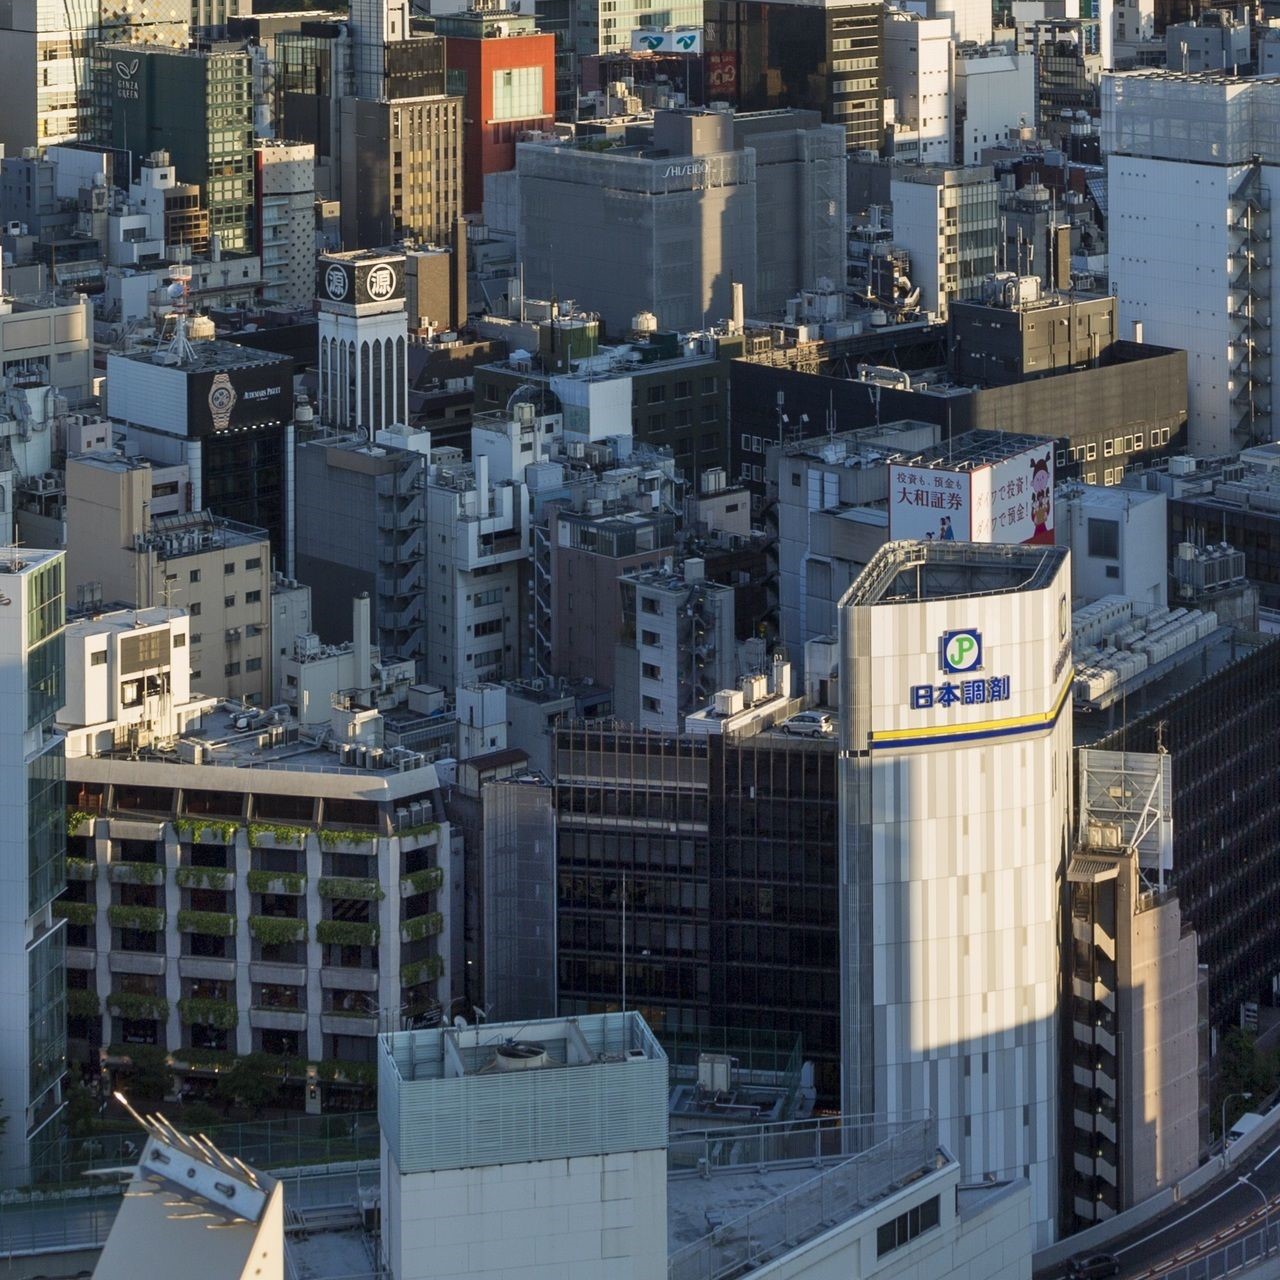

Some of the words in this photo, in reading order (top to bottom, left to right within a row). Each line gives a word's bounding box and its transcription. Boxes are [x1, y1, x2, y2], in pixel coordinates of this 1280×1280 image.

[117, 80, 139, 90] GINZA
[117, 90, 139, 99] GREEN
[662, 163, 708, 178] SHISEIDO
[328, 271, 344, 296] 源
[370, 269, 392, 295] 源
[897, 471, 962, 490] 投資も、預金も
[897, 487, 963, 511] 大和証券
[911, 674, 1010, 710] 日本調剤
